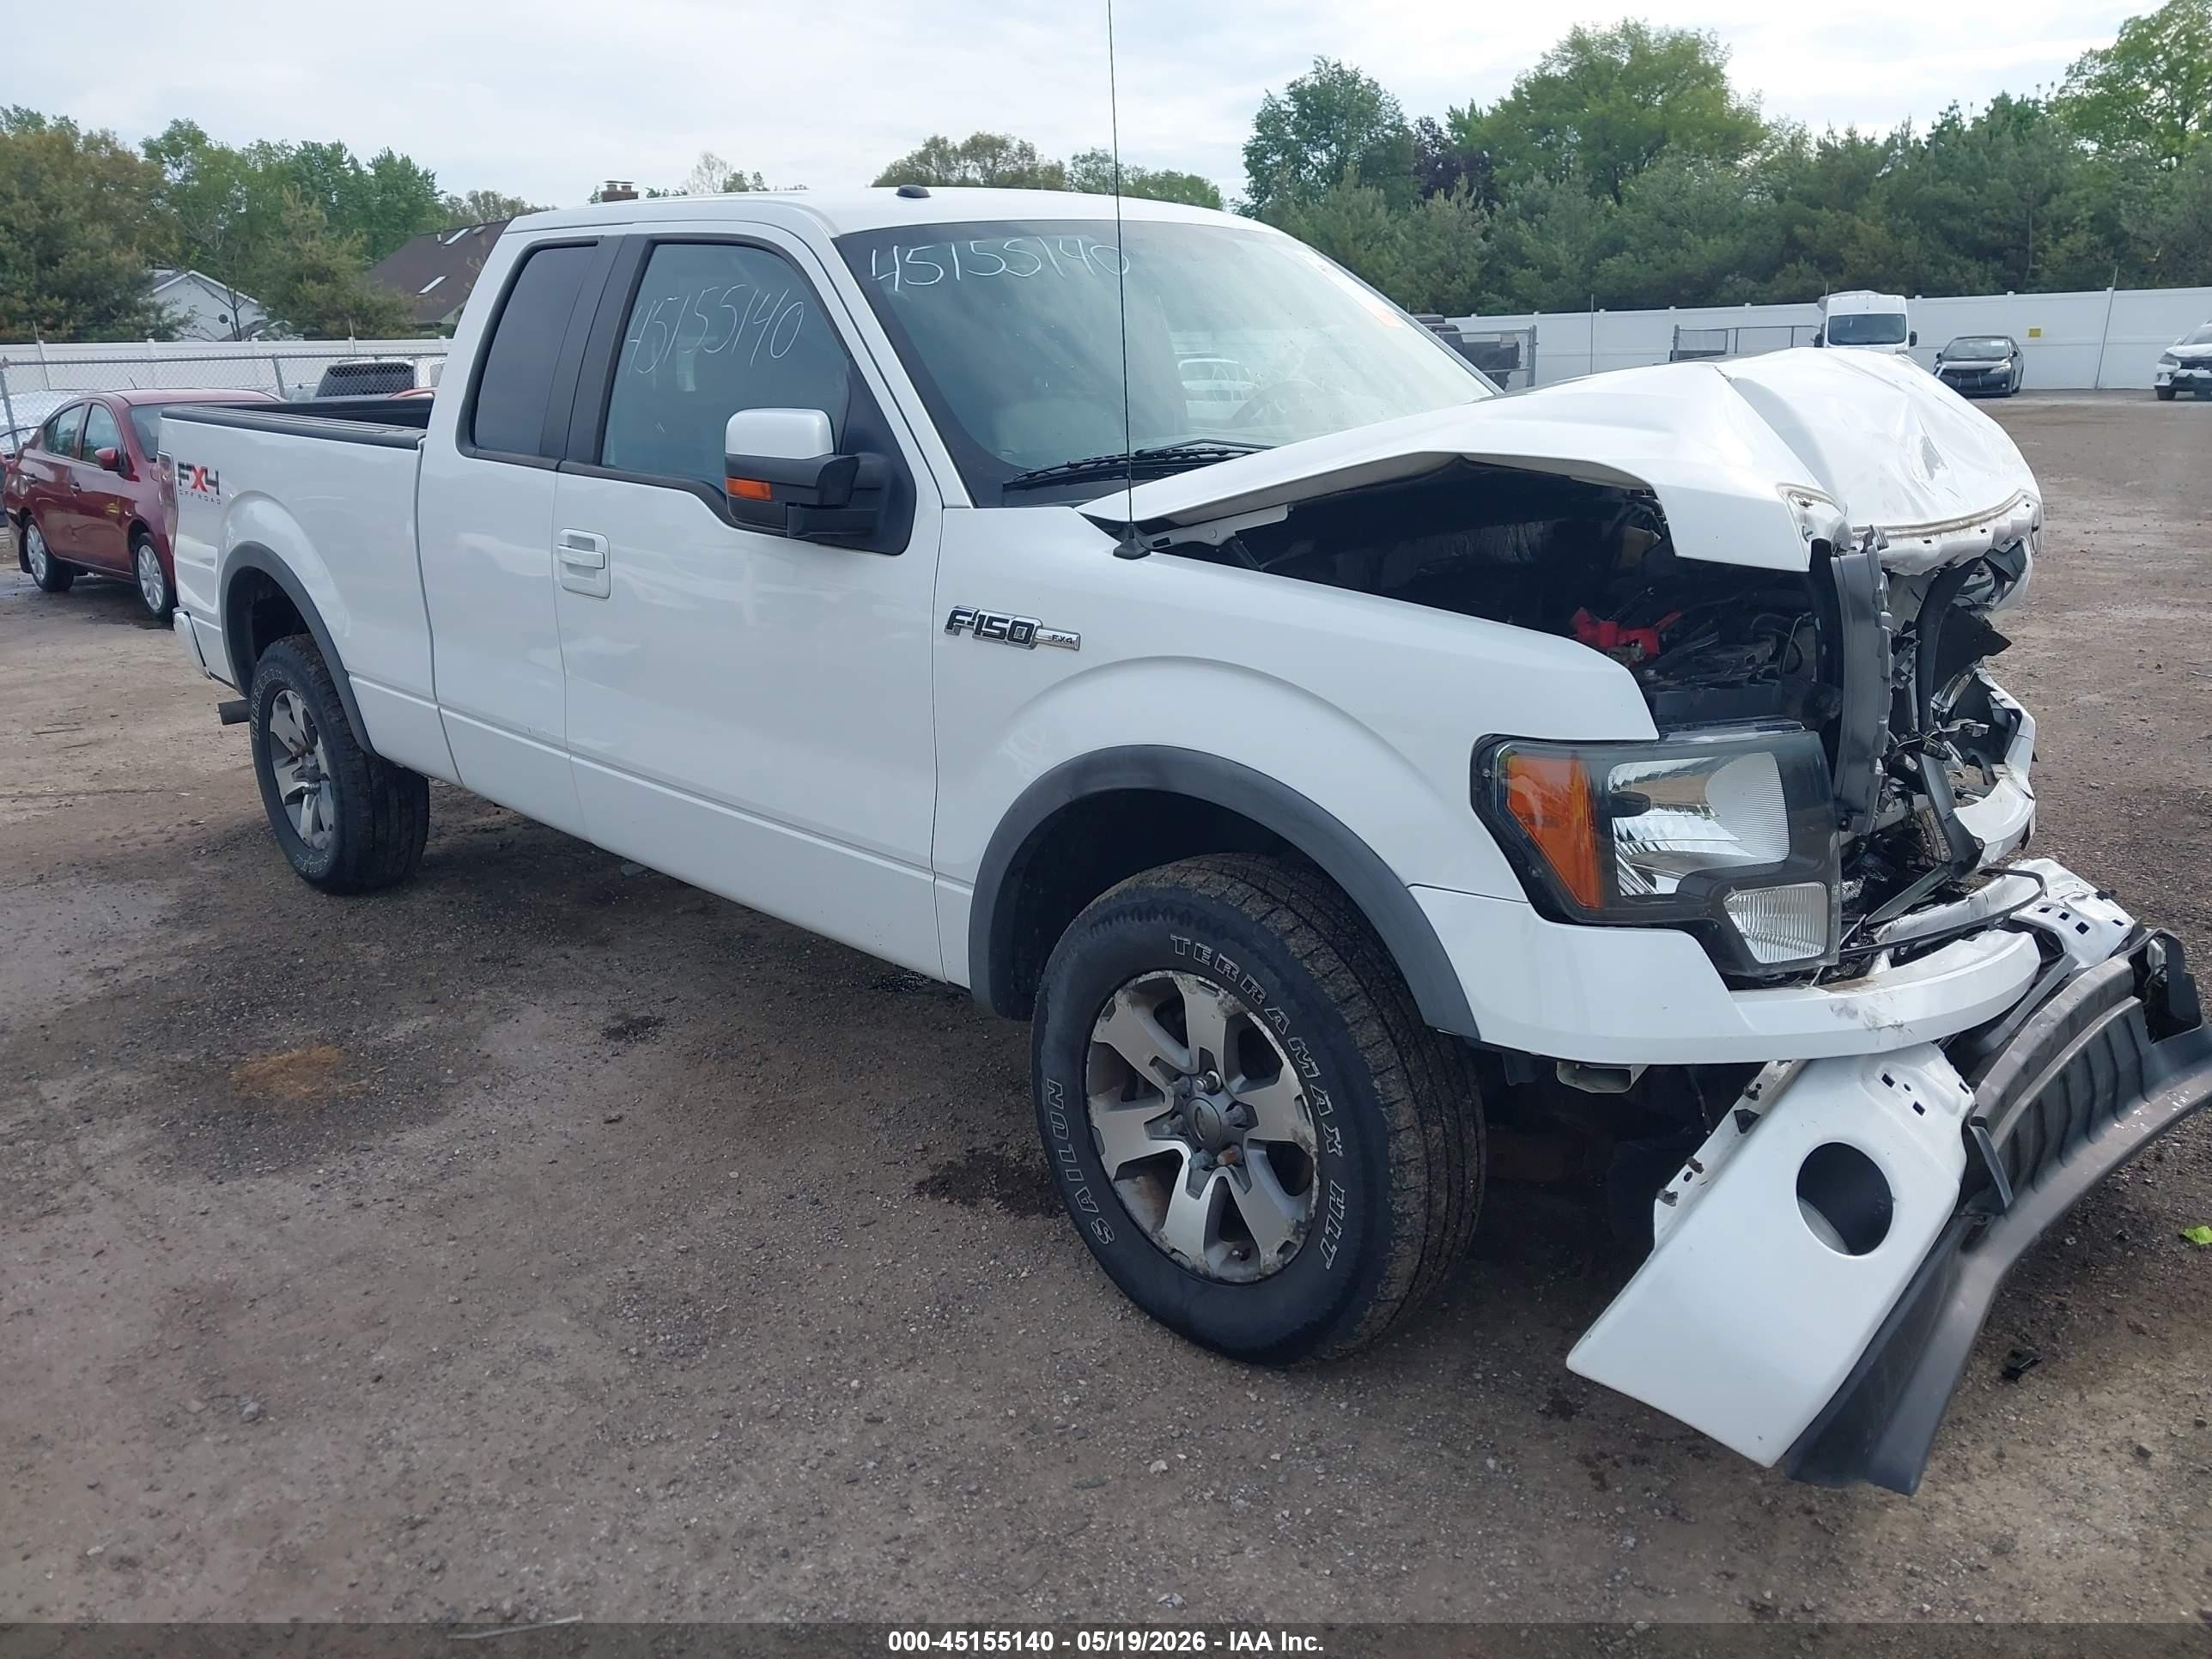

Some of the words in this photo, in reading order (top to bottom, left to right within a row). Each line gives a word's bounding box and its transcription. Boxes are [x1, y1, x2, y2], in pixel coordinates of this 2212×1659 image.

[872, 234, 1131, 292] 45155140
[627, 284, 805, 376] 45155140
[177, 460, 221, 496] FX4
[944, 605, 1044, 650] F-150
[1051, 634, 1073, 645] FX4
[1170, 933, 1346, 1158] TERRAMAX
[1045, 1078, 1116, 1245] SAILUN
